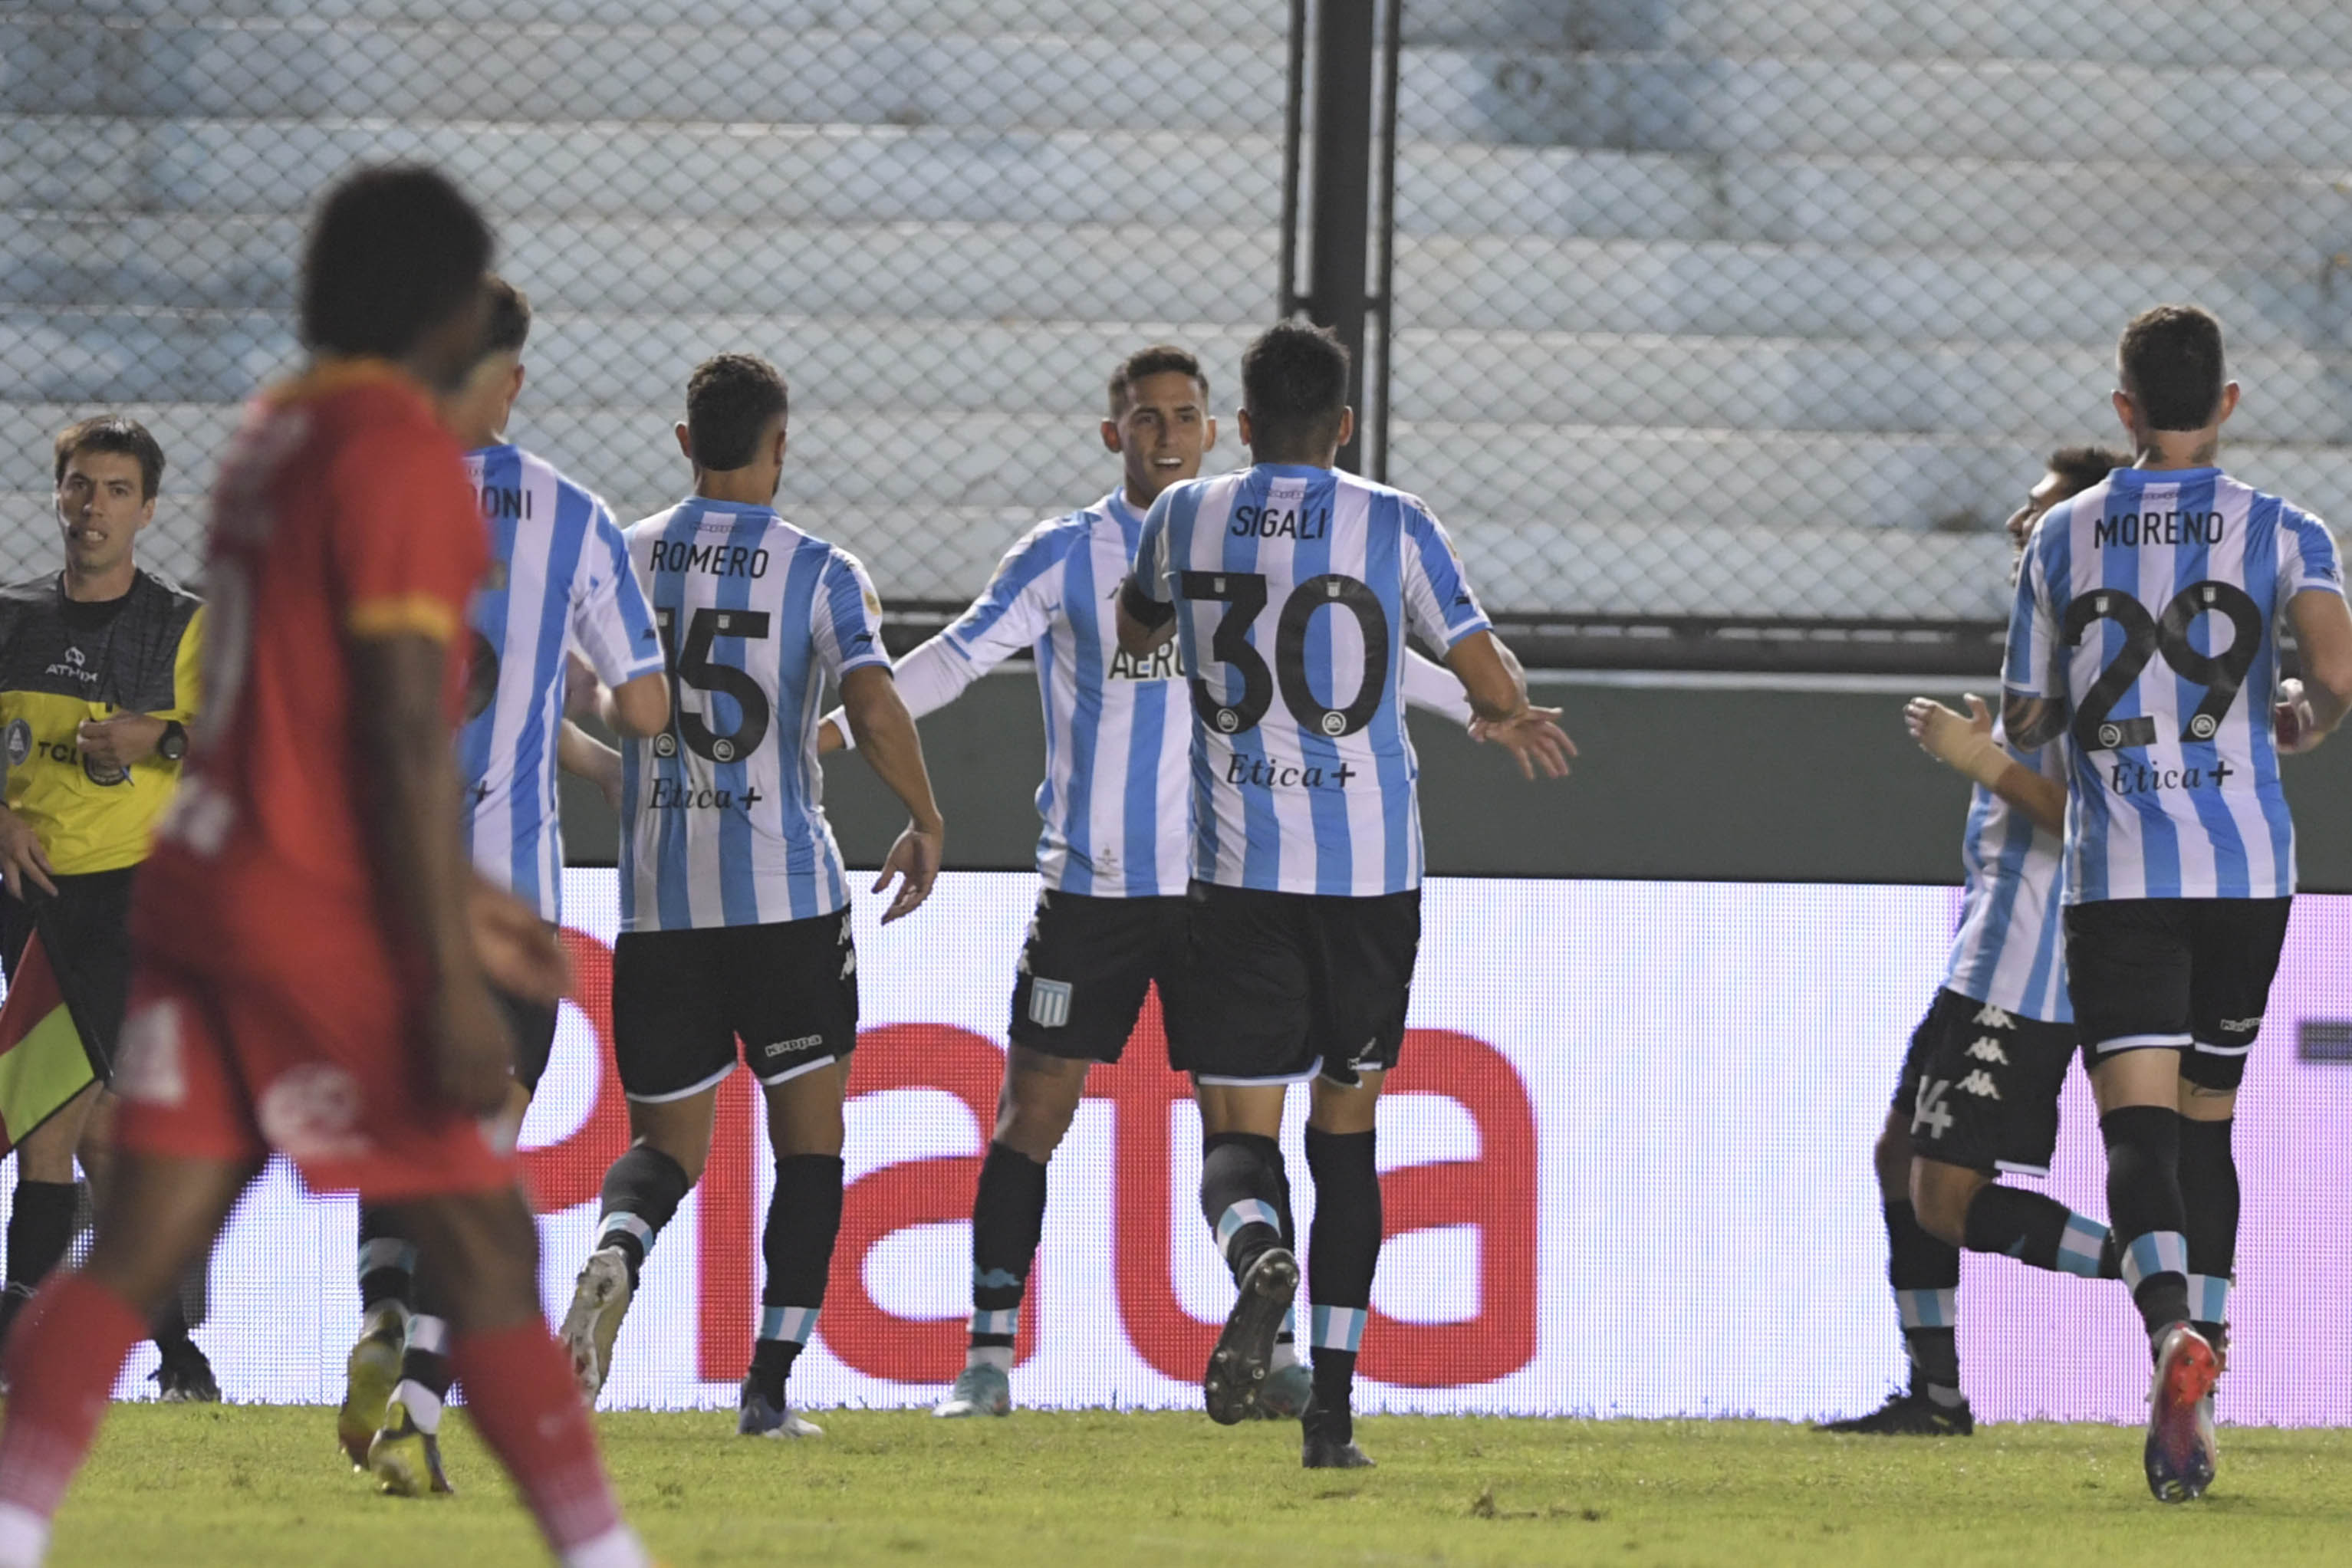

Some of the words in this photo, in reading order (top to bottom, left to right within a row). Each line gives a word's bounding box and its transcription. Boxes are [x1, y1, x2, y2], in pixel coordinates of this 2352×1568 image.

[472, 486, 531, 521] ONI
[1232, 505, 1326, 539] SIGALI
[2094, 511, 2223, 549] MORENO
[650, 540, 769, 579] ROMERO
[1108, 638, 1186, 679] AER
[1181, 570, 1389, 737] 30
[2062, 580, 2263, 751] 29
[654, 607, 771, 763] 15
[1910, 1075, 1952, 1139] 14
